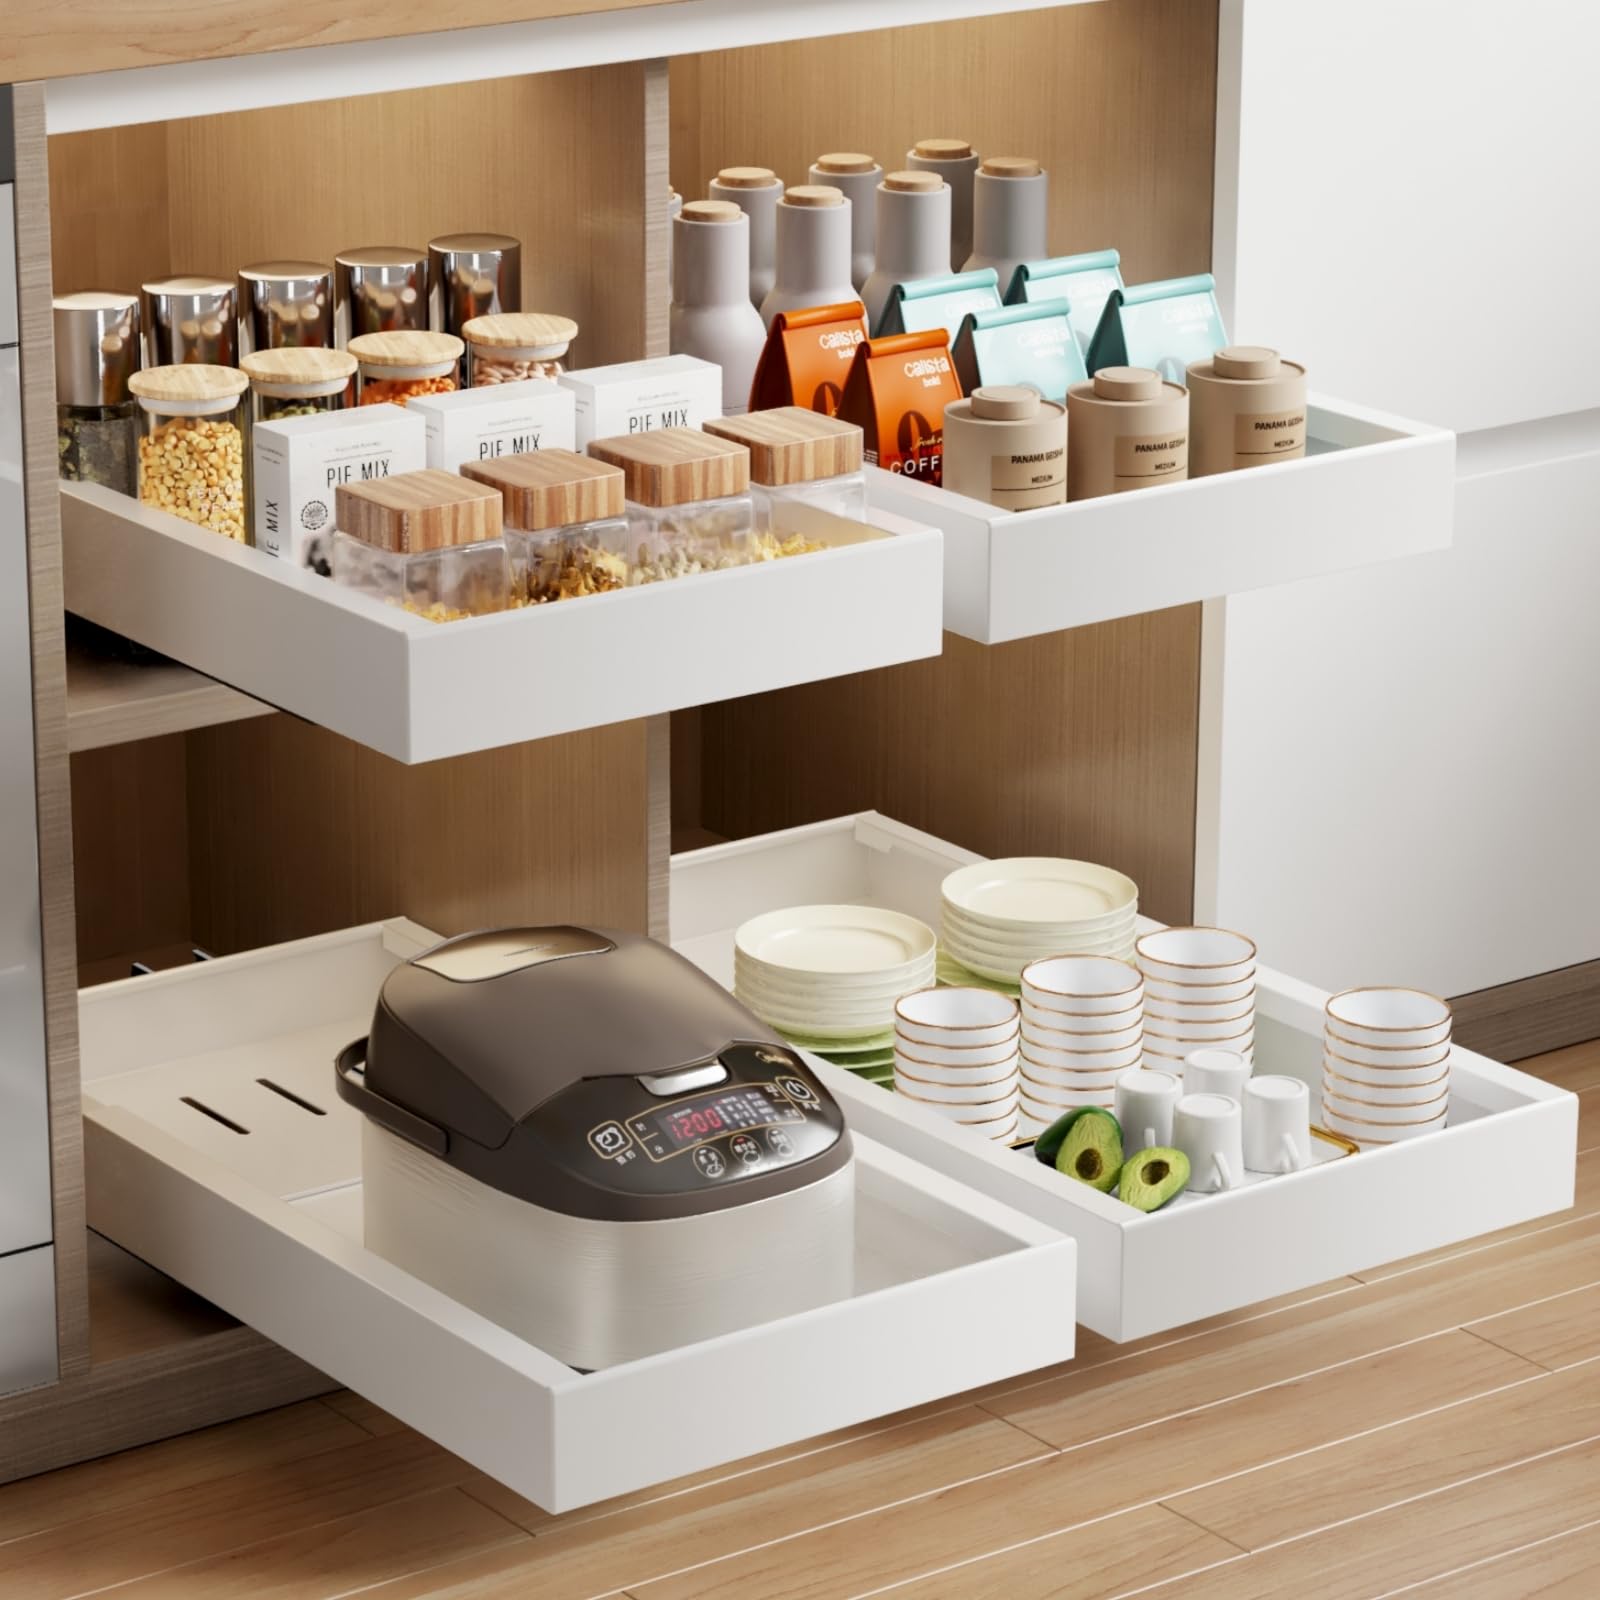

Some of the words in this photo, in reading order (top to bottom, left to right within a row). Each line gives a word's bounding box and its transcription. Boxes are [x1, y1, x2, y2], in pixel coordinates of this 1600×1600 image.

[904, 356, 950, 378] Calista
[662, 408, 688, 428] MIX
[1255, 421, 1286, 431] PANAMA
[513, 433, 541, 454] MIX
[1135, 442, 1168, 454] PANAMA
[890, 455, 939, 475] COFF
[1011, 451, 1045, 465] PANAMA
[361, 459, 390, 480] MIX
[266, 499, 279, 533] MIX
[265, 539, 279, 558] IE
